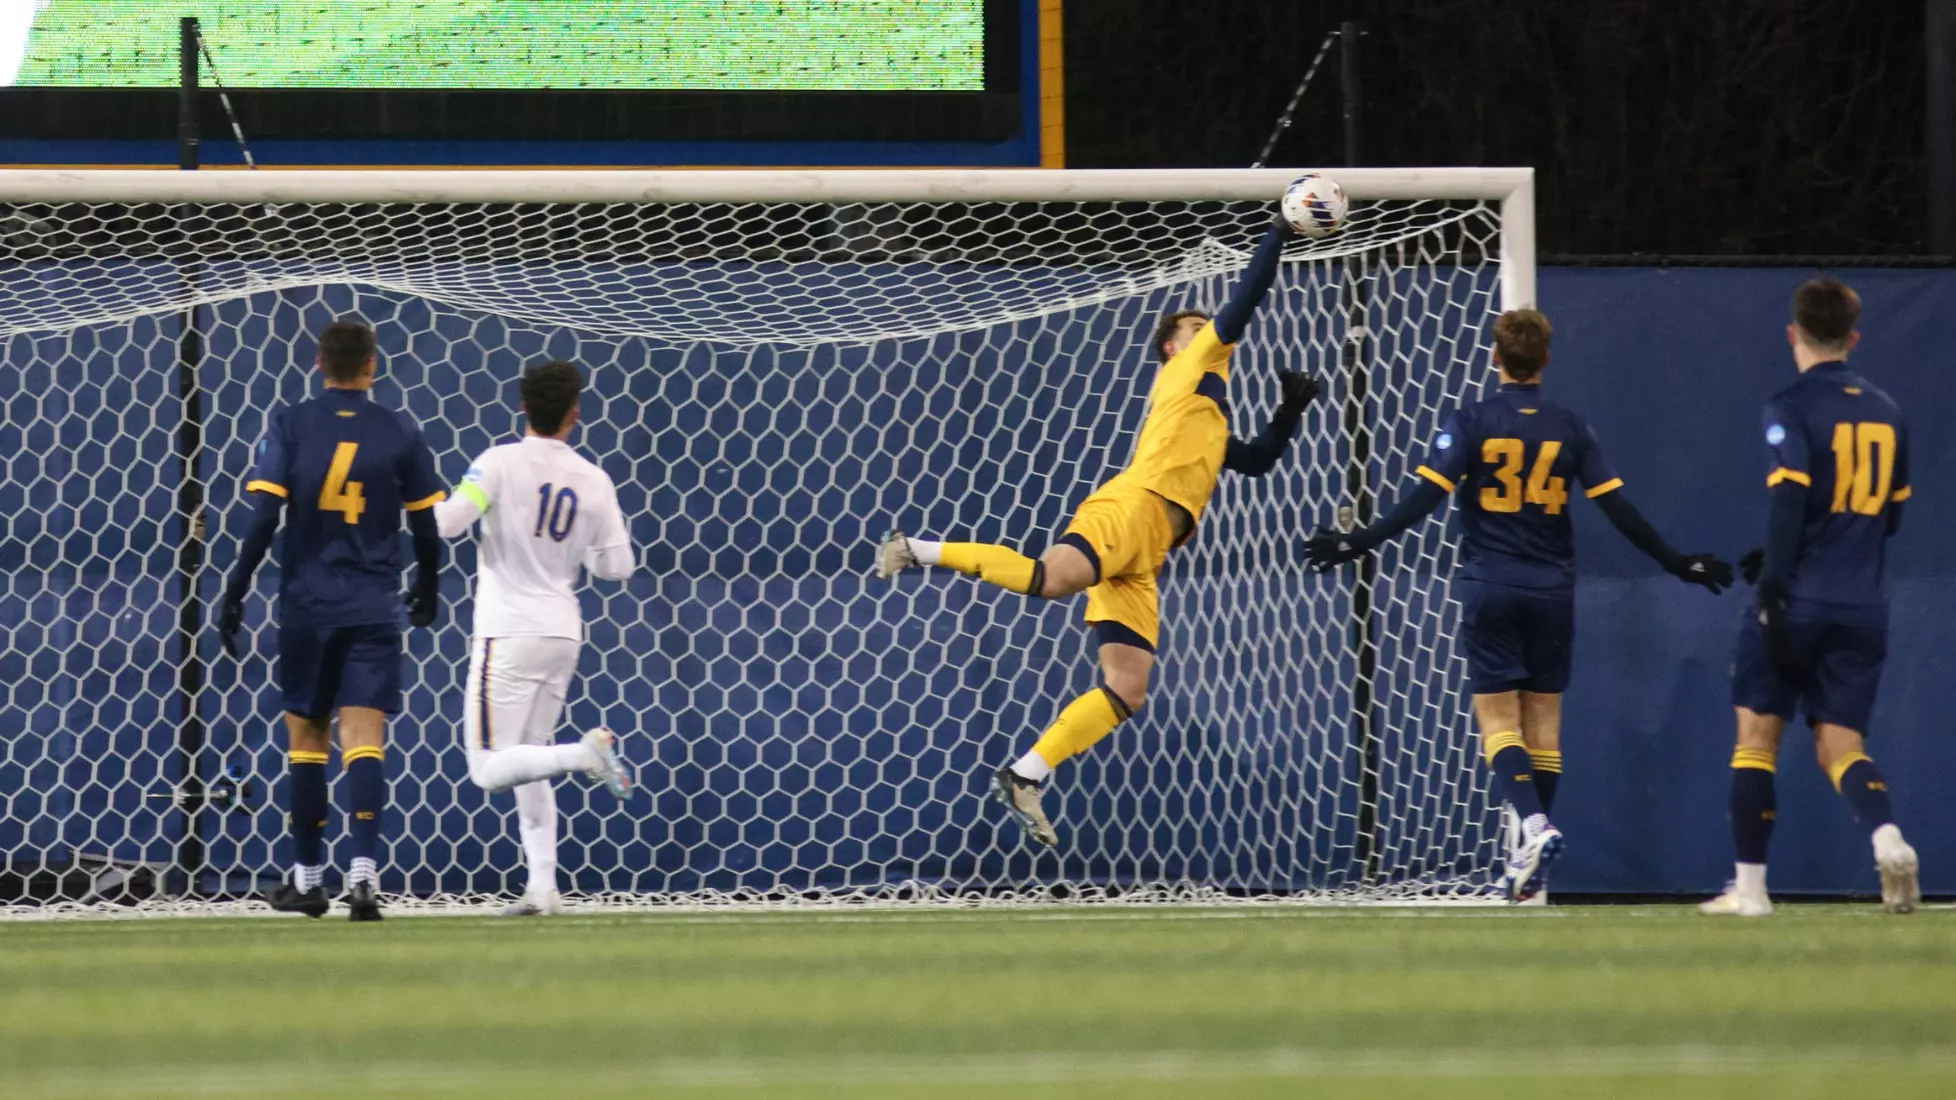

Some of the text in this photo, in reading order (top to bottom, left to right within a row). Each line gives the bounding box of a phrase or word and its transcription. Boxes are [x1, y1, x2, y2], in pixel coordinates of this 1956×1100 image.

[318, 442, 367, 525] 4
[1480, 438, 1568, 514] 34
[1831, 421, 1896, 516] 10
[534, 482, 578, 542] 10
